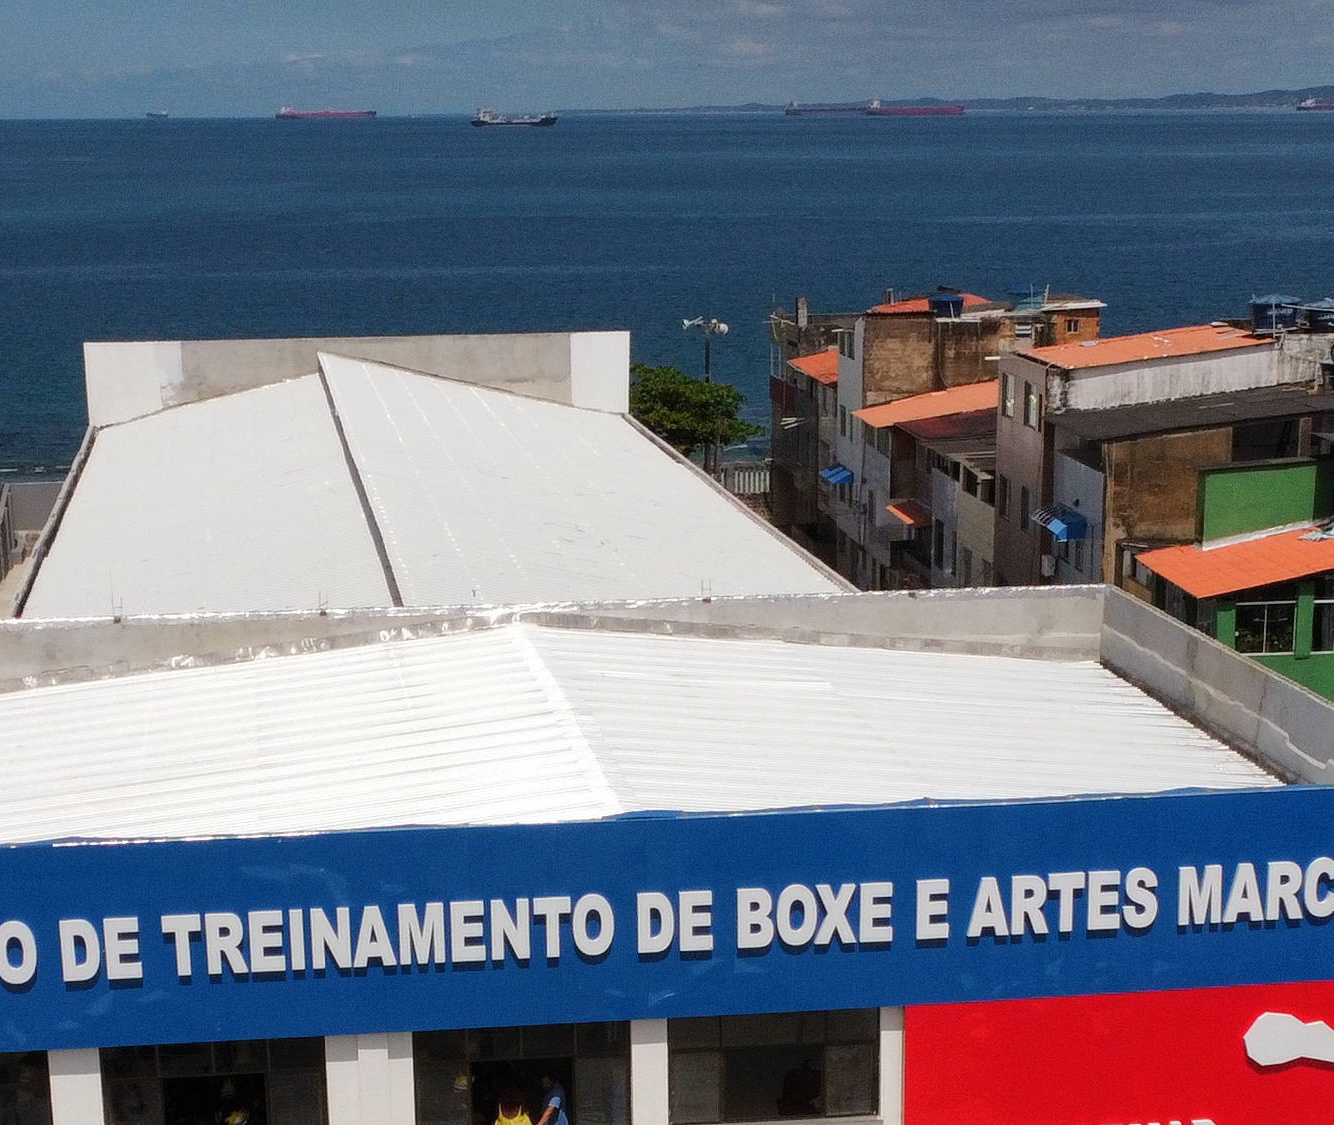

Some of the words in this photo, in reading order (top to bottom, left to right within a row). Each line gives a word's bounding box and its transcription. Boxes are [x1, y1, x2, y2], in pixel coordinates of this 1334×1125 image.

[59, 917, 143, 981] DE
[161, 894, 615, 976] TREINAMENTO
[637, 890, 714, 954] DE
[737, 882, 894, 949] BOXE
[917, 879, 950, 940] E
[968, 867, 1159, 938] ARTES
